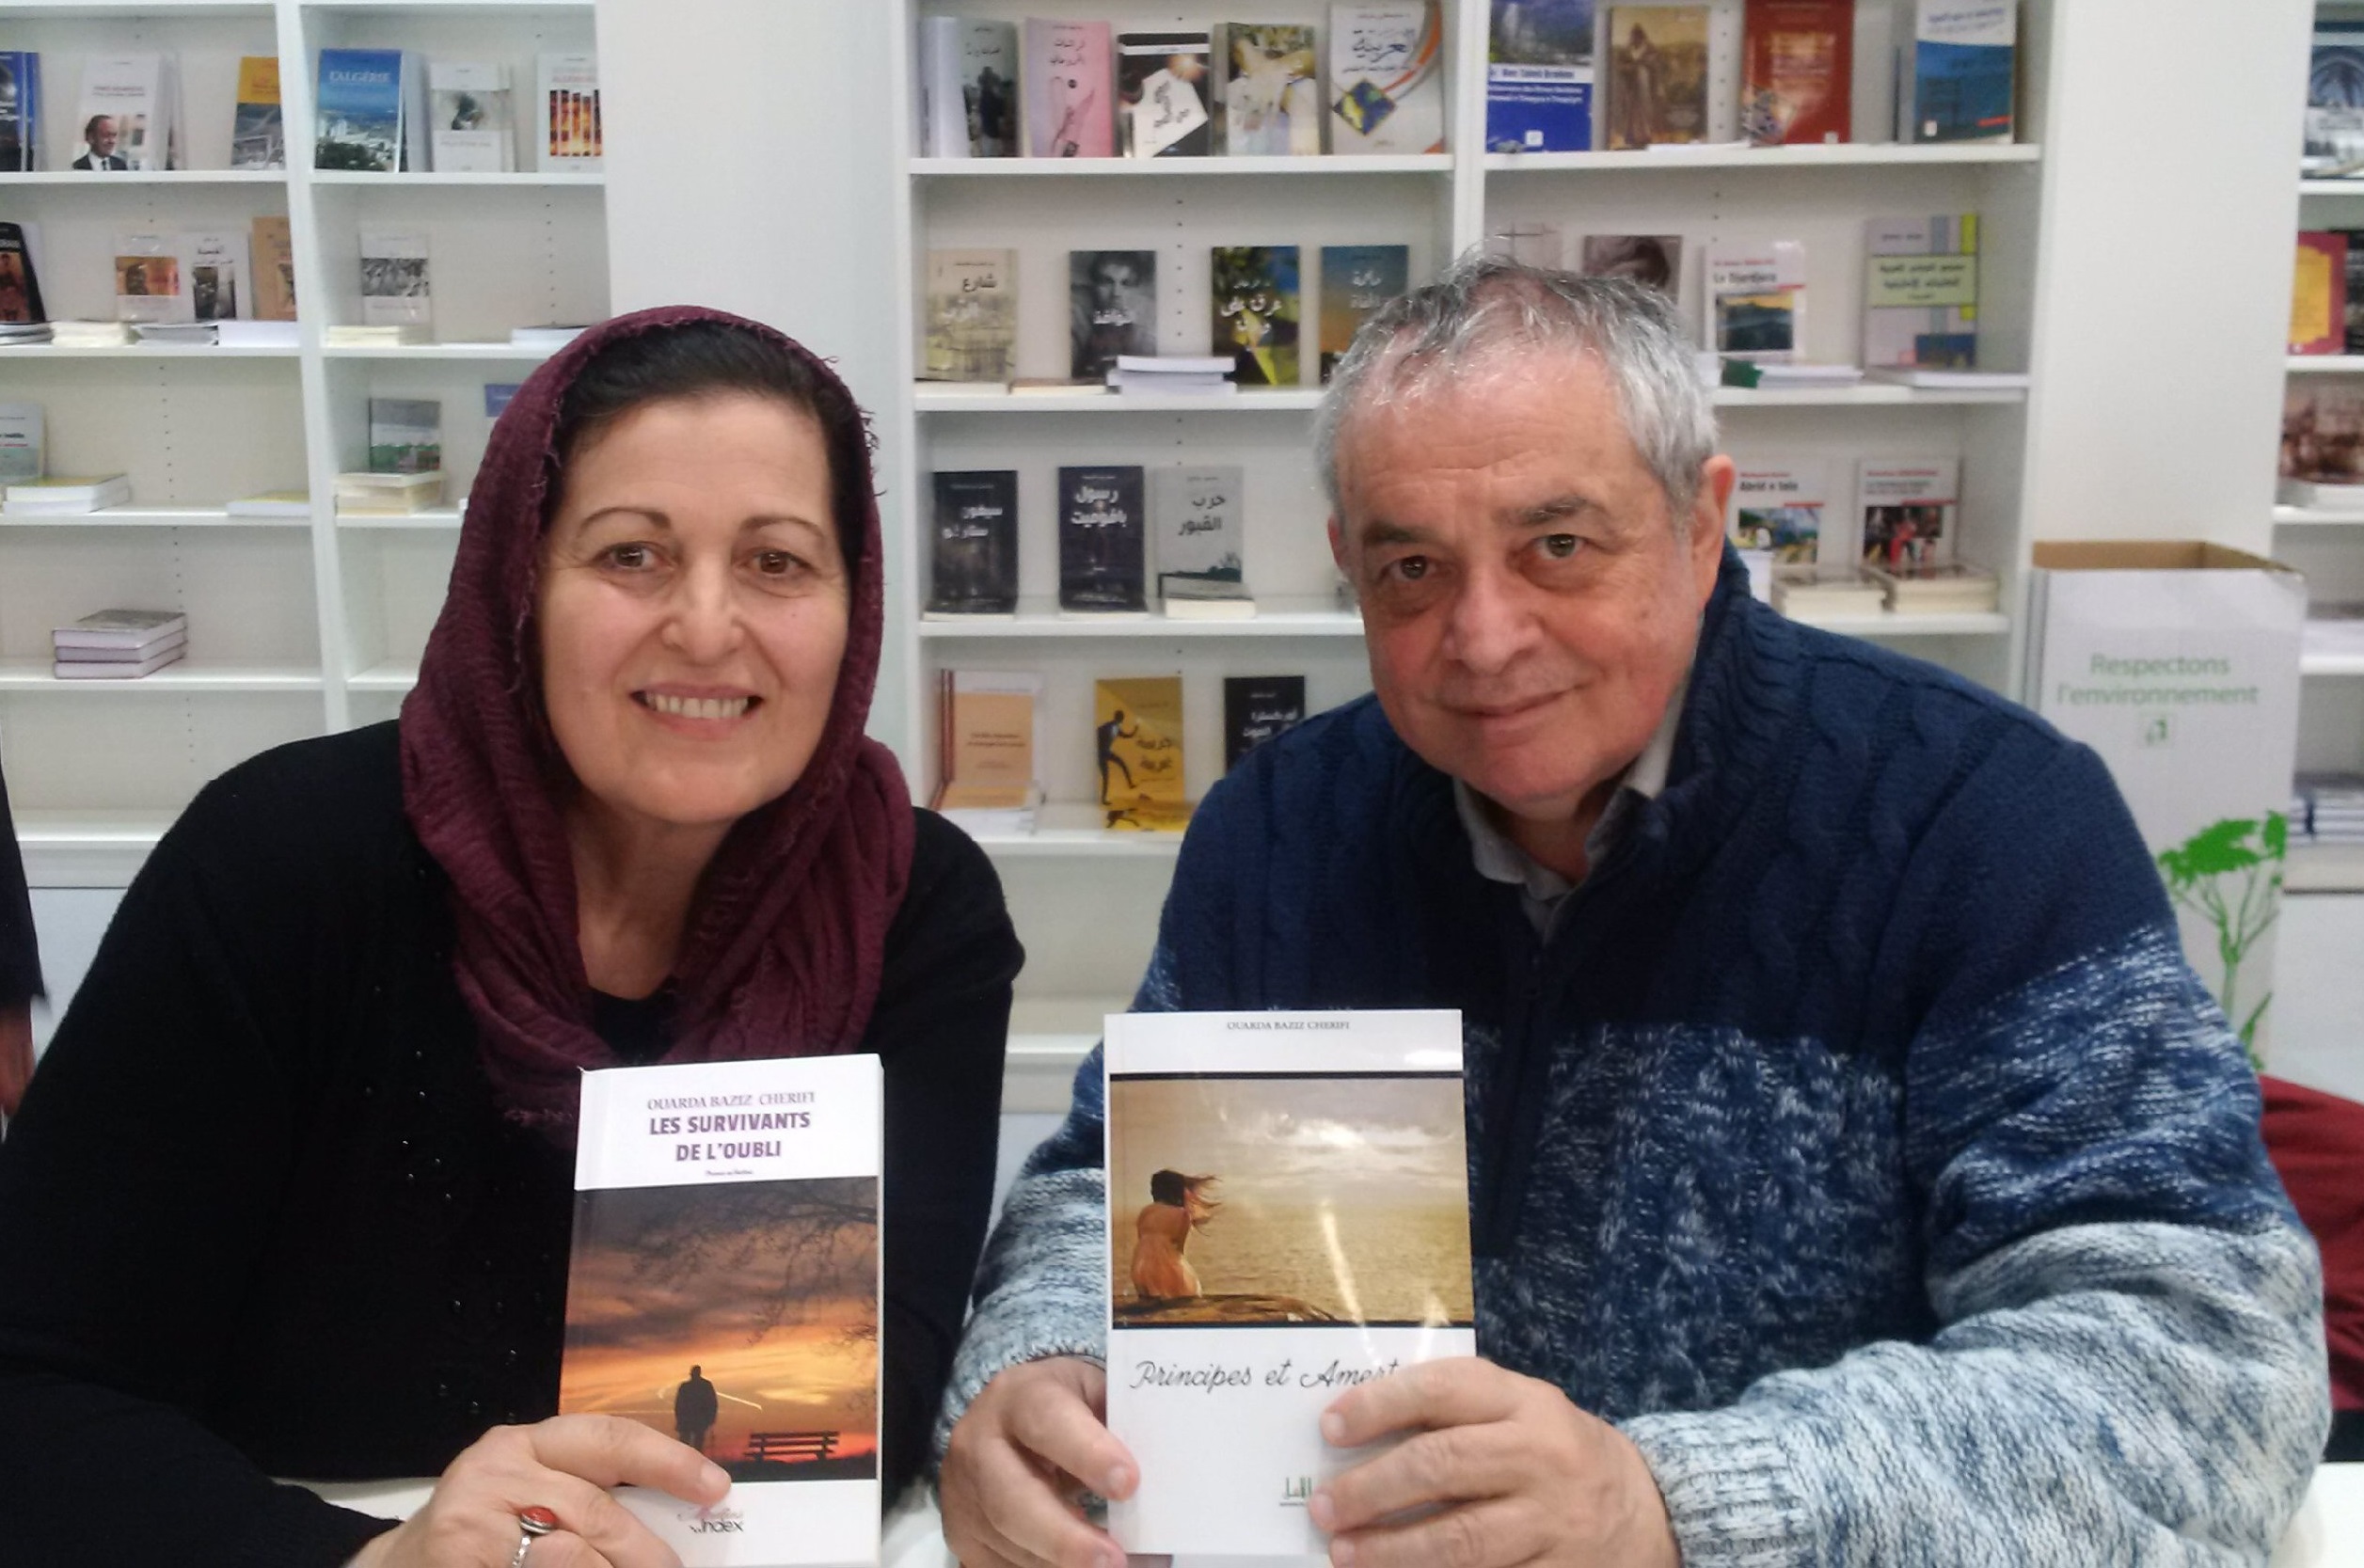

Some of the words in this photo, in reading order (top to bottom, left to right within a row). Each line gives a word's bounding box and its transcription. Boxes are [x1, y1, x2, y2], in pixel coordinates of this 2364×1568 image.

[2089, 653, 2231, 676] Respectons
[2057, 684, 2259, 705] l'environnement
[1227, 1022, 1272, 1030] OUARDA
[1274, 1022, 1305, 1030] BAZIZ
[647, 1097, 707, 1111] OUARDA
[709, 1094, 753, 1108] BAZIZ
[649, 1117, 681, 1135] LES
[688, 1112, 811, 1132] SURVIVANTS
[675, 1144, 701, 1161] DE
[706, 1140, 781, 1160] L'OUBLI
[1129, 1360, 1251, 1393] Principes
[1265, 1358, 1291, 1386] et
